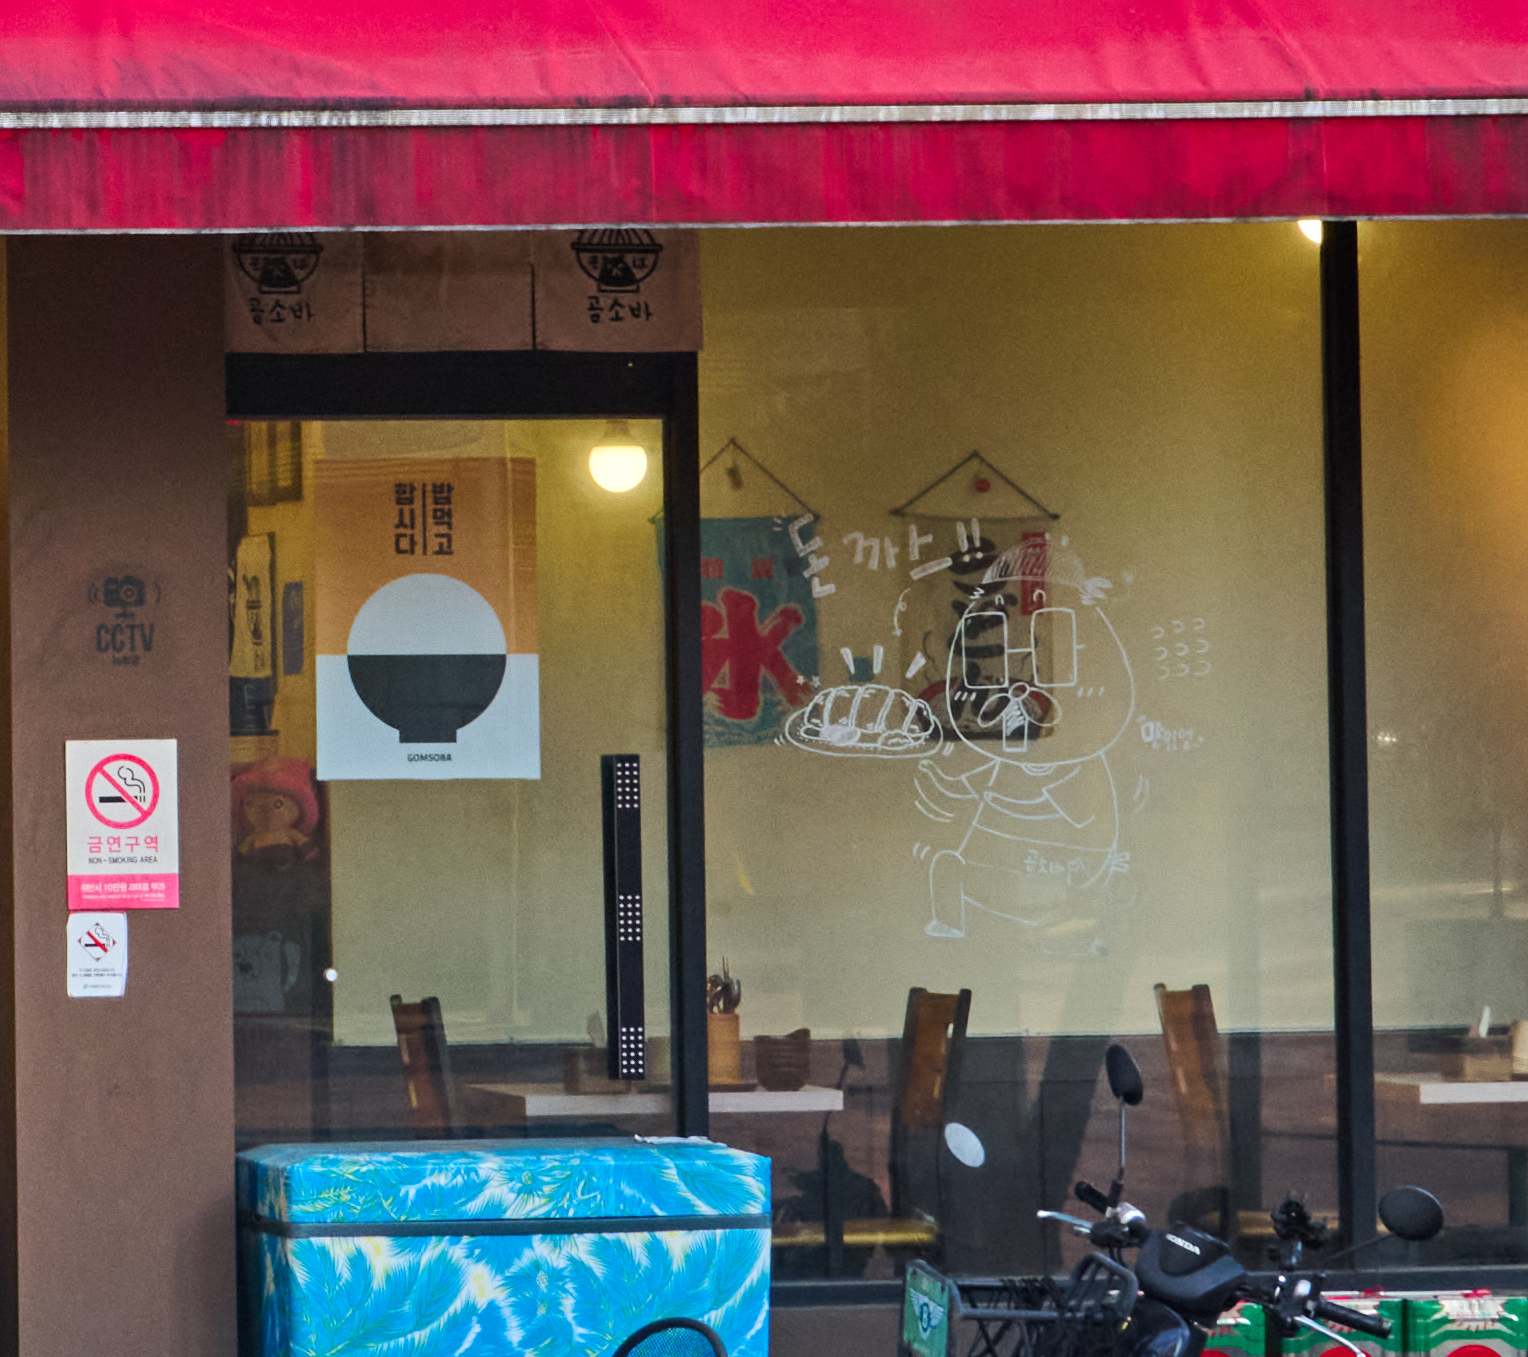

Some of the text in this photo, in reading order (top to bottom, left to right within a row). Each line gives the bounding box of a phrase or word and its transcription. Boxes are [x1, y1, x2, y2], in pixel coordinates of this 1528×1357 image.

[249, 297, 316, 325] 곰소바
[587, 294, 654, 323] 곰소바
[96, 623, 154, 653] CCTV
[407, 753, 453, 762] GOMSOBA
[87, 835, 160, 854] 금연구역
[140, 856, 158, 864] AREA
